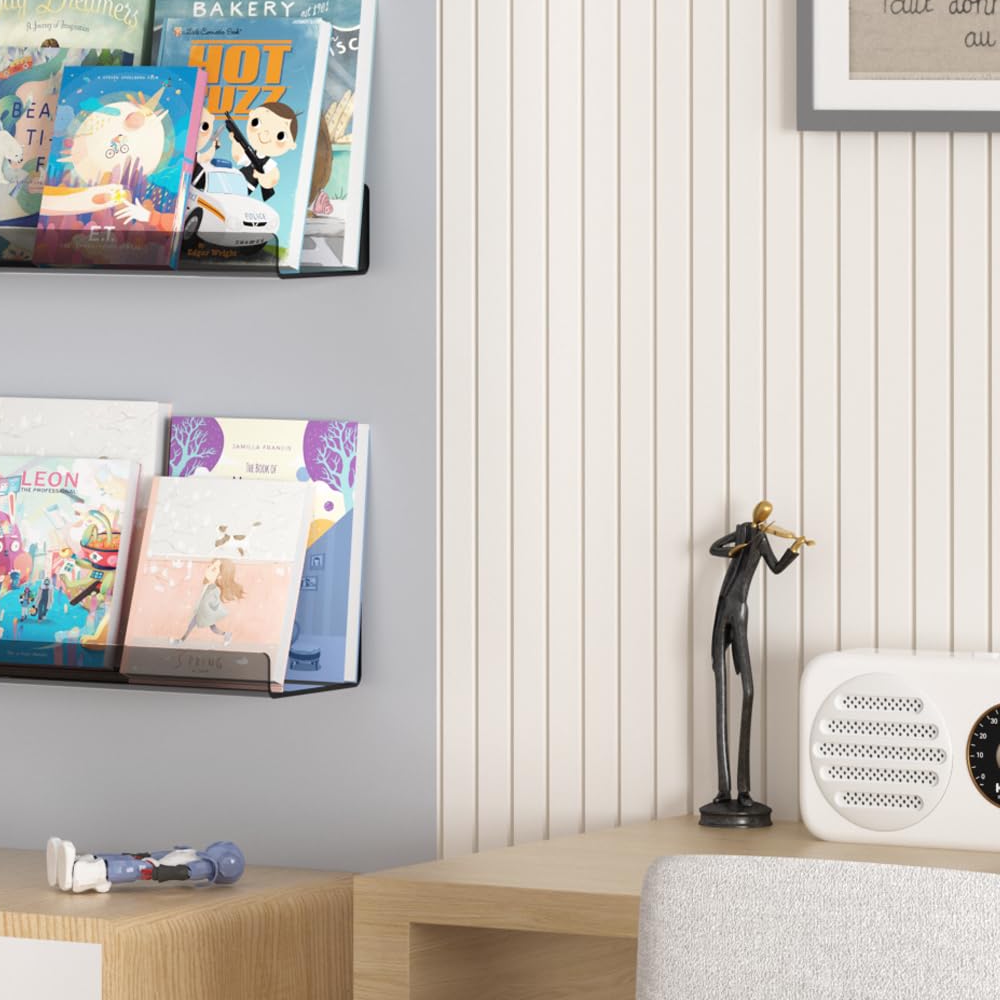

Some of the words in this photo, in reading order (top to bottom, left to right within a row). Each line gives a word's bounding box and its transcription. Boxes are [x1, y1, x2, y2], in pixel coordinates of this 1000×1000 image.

[193, 1, 296, 18] BAKERY
[964, 31, 997, 48] au
[188, 44, 293, 85] HOT
[203, 86, 288, 115] UZZ
[21, 470, 79, 488] LEON
[979, 732, 987, 740] 20
[976, 751, 984, 759] 10
